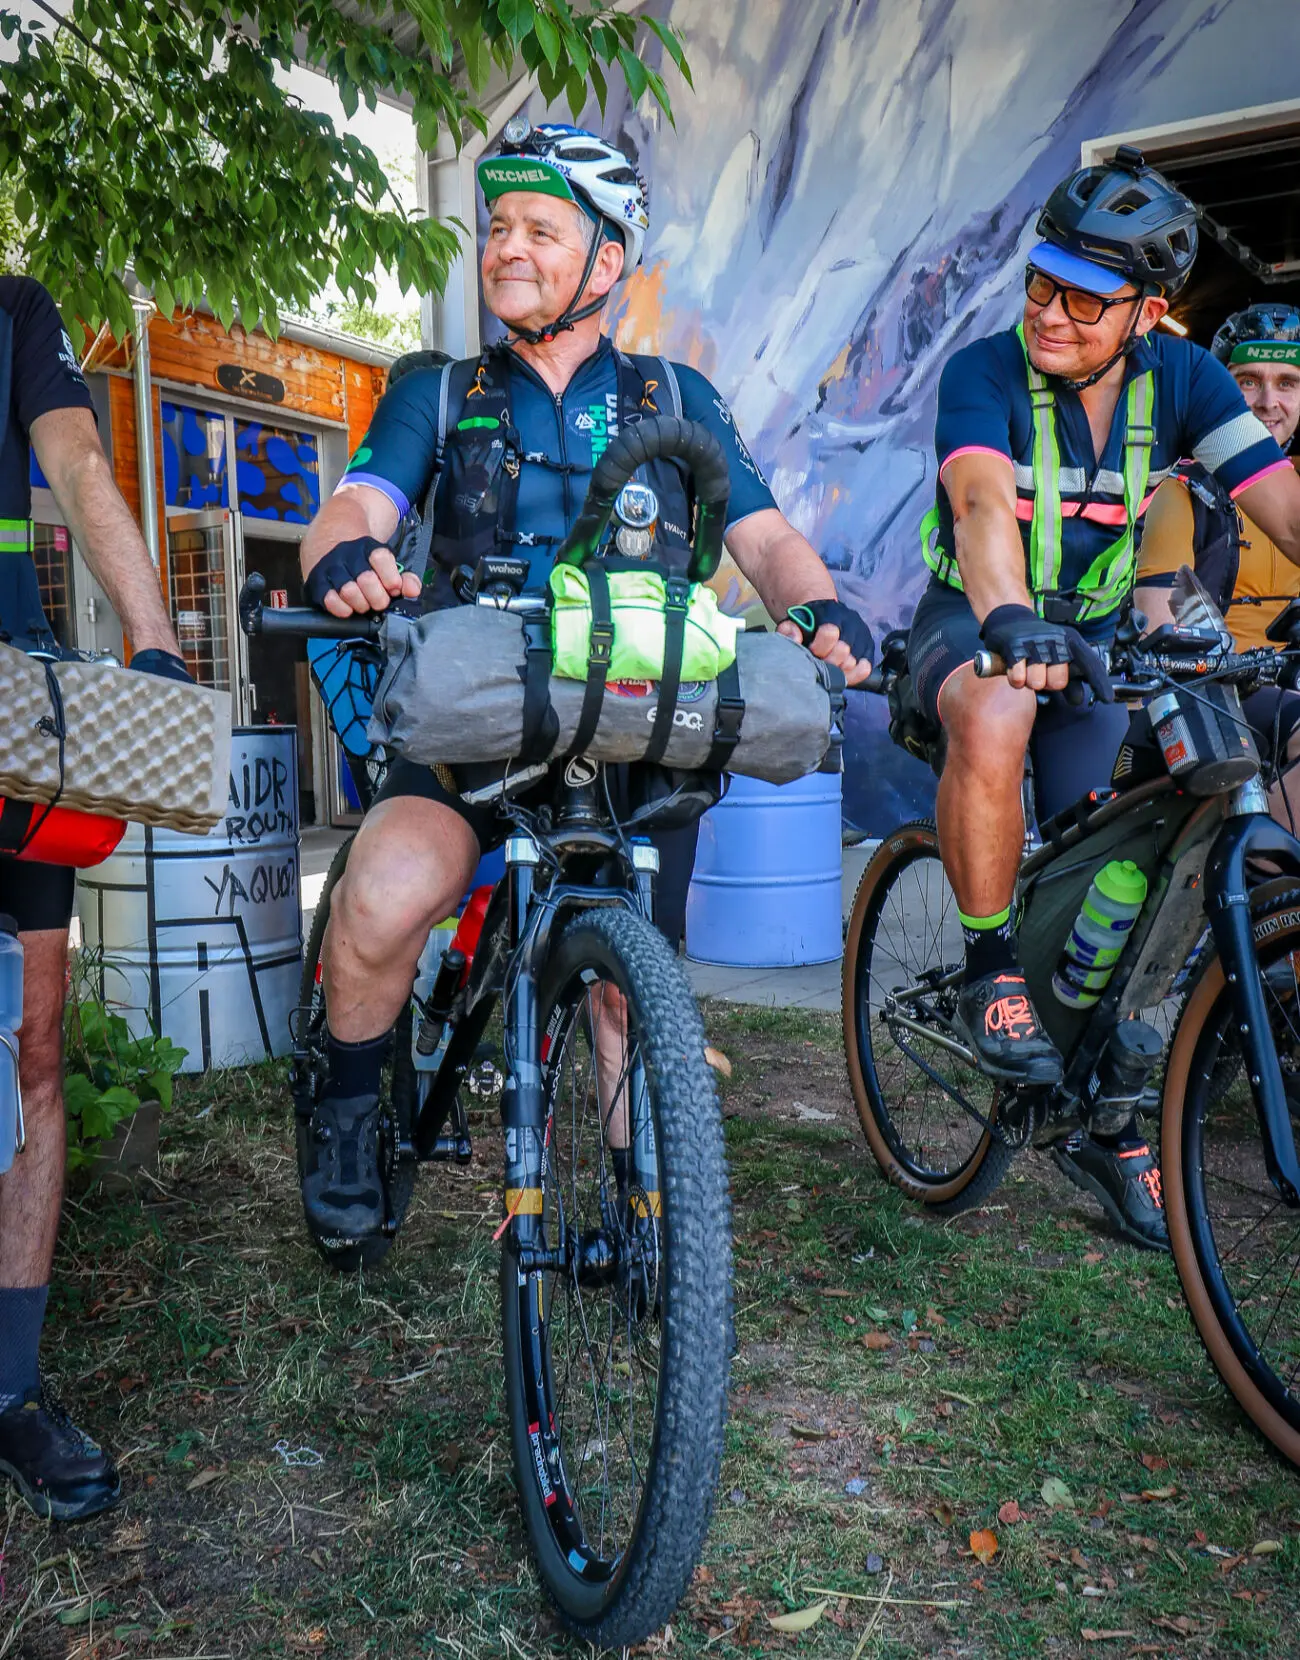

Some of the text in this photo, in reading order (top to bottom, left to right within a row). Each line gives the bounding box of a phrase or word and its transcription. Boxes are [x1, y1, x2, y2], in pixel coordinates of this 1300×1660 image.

[485, 168, 551, 184] MICHEL
[1247, 346, 1299, 359] NICK
[488, 562, 523, 576] wahoo
